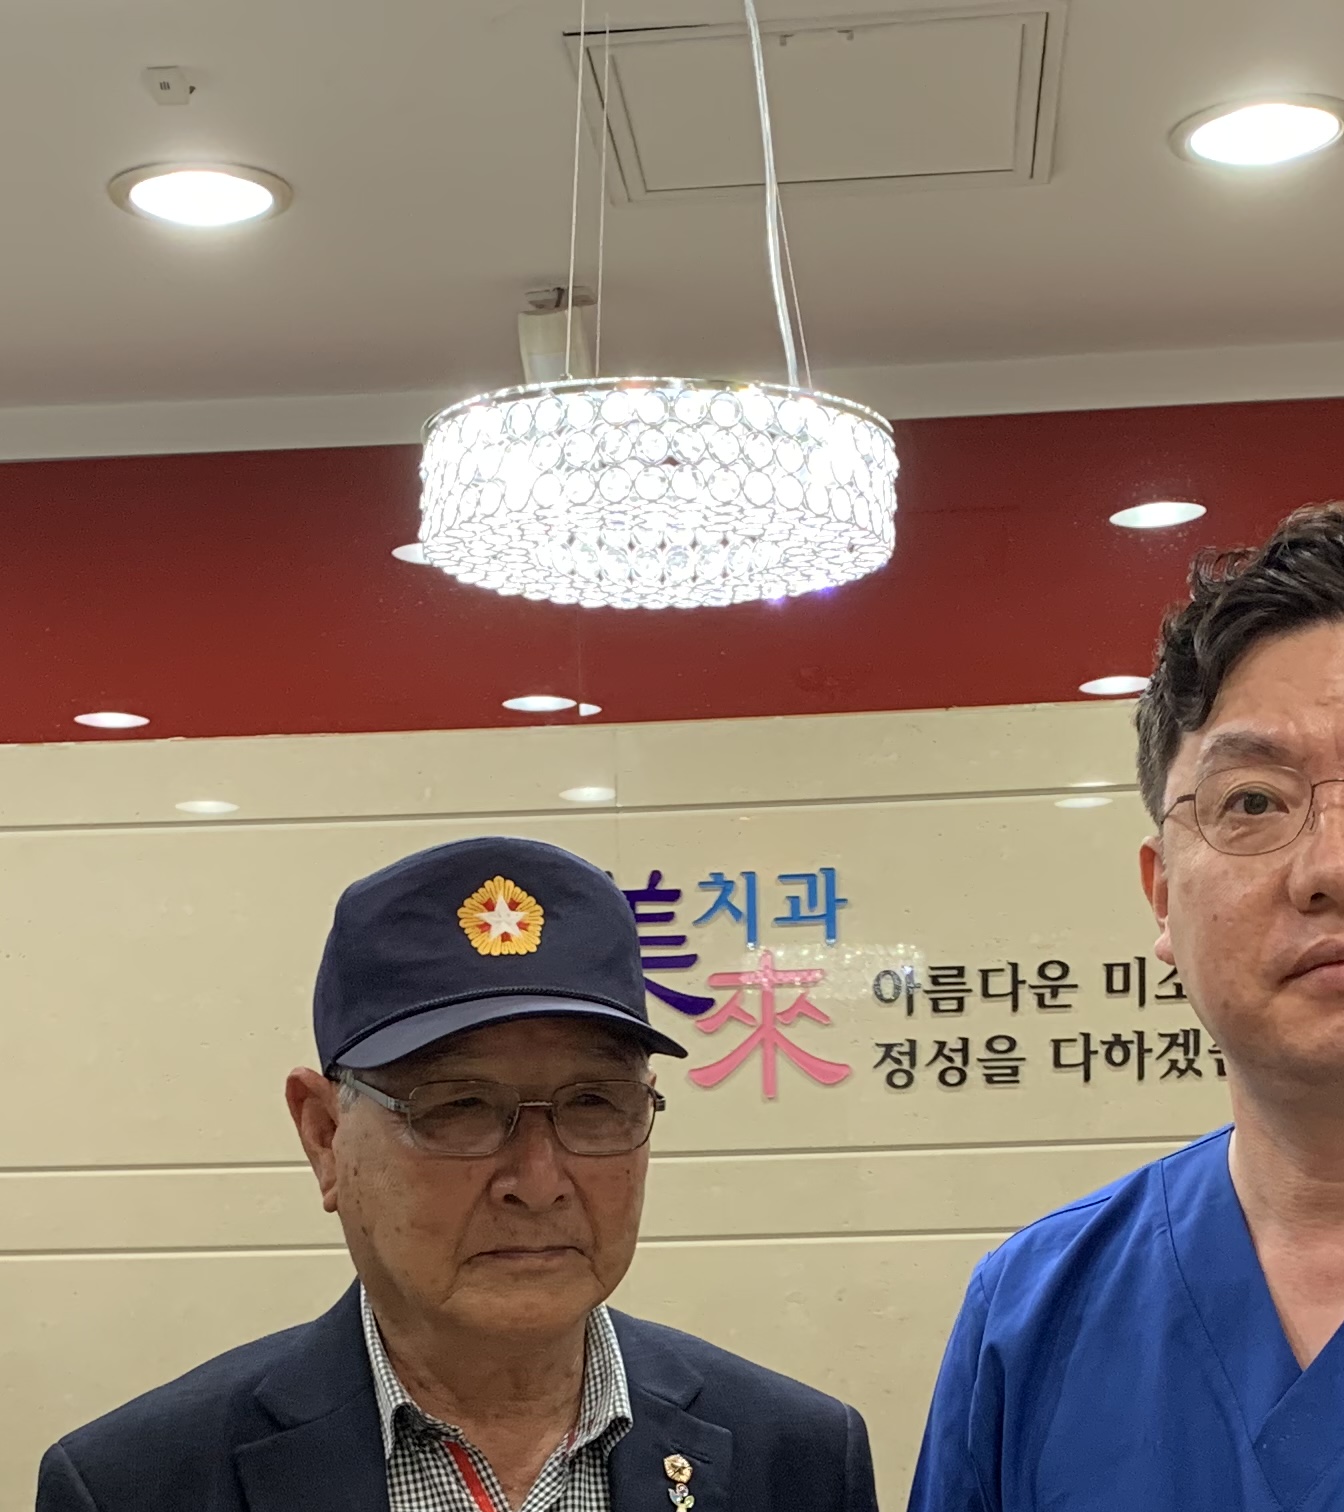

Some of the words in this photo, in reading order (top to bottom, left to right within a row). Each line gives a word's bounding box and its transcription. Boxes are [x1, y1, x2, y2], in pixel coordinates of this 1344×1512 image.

[692, 867, 848, 948] 치과
[873, 959, 1079, 1016] 아름다운
[688, 950, 851, 1100] 來
[873, 1034, 1026, 1088] 정성을
